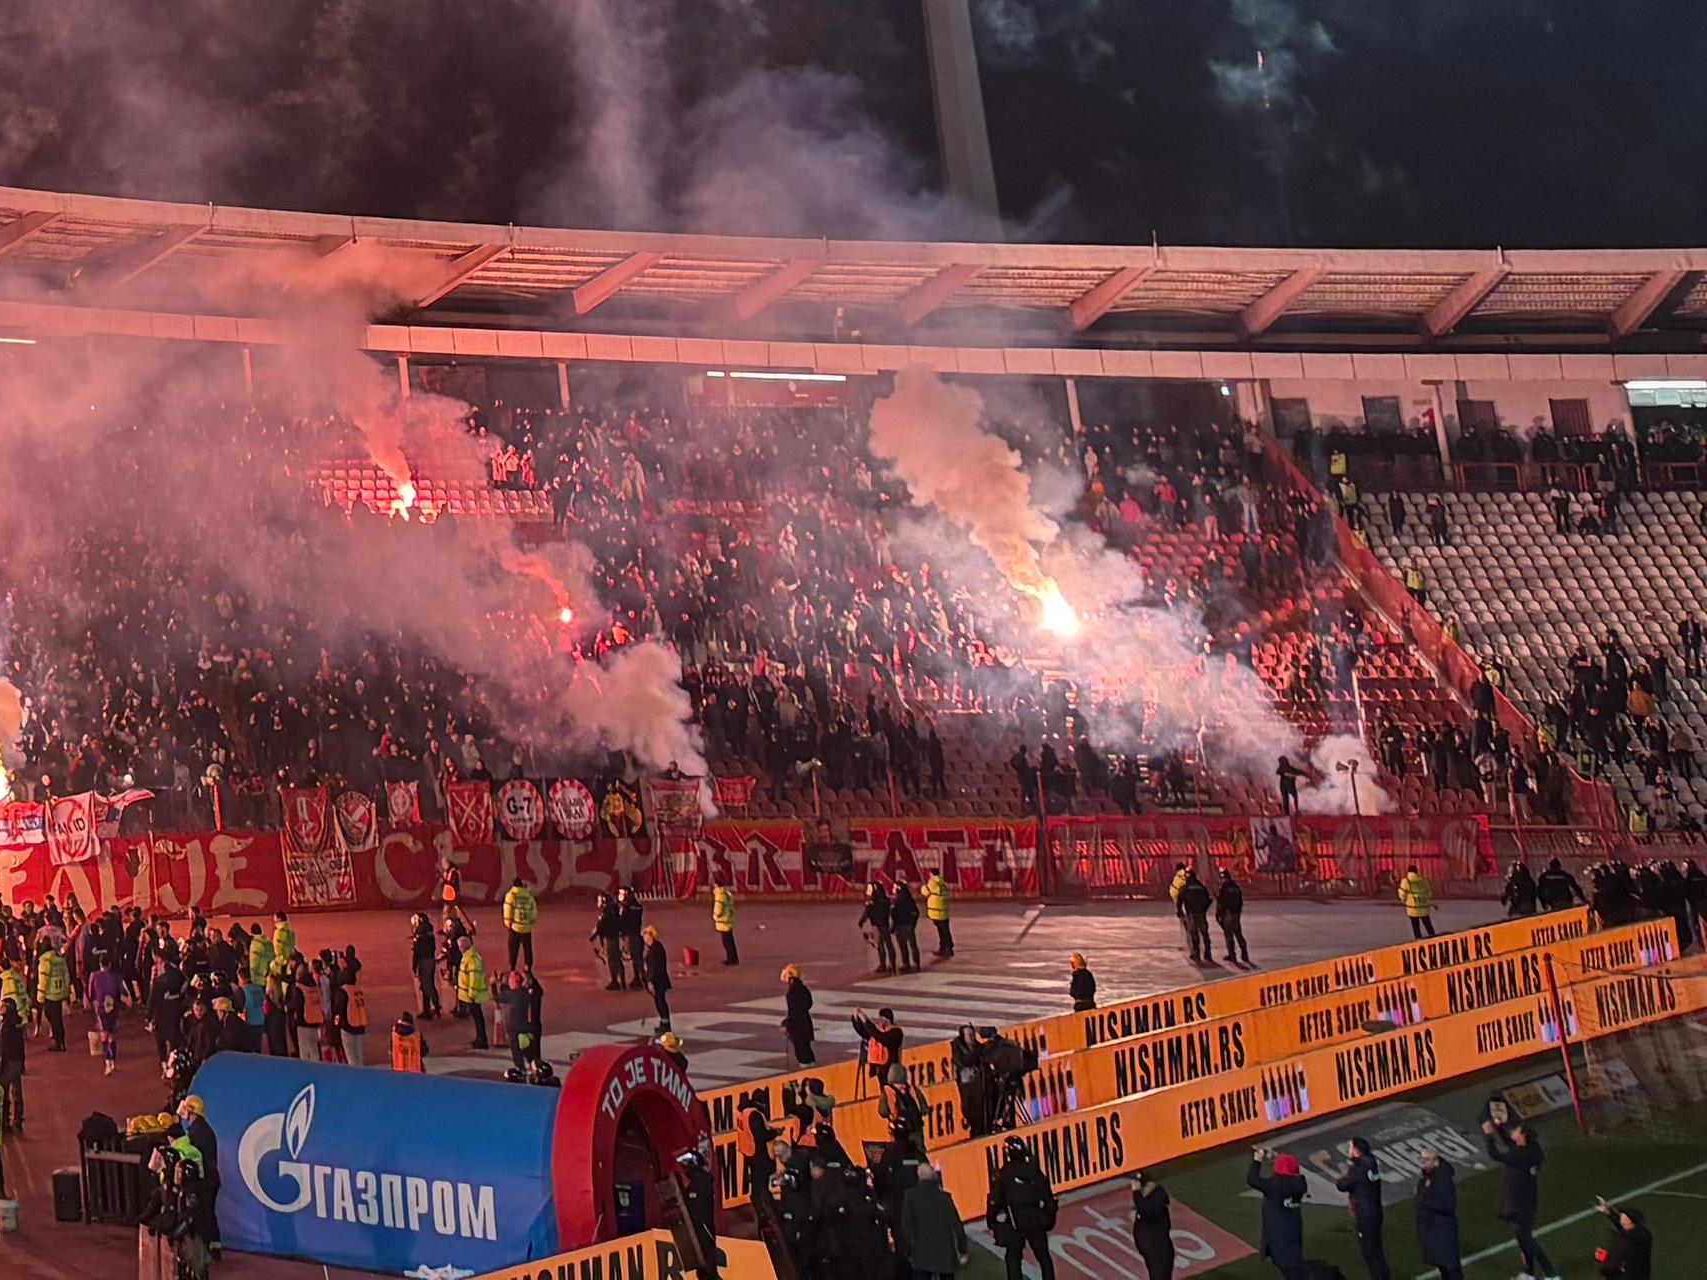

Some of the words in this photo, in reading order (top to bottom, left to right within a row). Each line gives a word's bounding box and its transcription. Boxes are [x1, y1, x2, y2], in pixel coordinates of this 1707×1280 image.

[506, 796, 533, 816] G-7
[1446, 952, 1543, 1014] NISHMAN.RS
[1299, 1008, 1334, 1044] AFTER
[1336, 999, 1372, 1034] SHAVE
[1476, 1020, 1506, 1054] AFTER
[1505, 1010, 1537, 1046] SHAVE
[1114, 1021, 1246, 1100] NISHMAN.RS
[1335, 1027, 1437, 1101] NISHMAN.RS
[1180, 1096, 1218, 1138] AFTER
[1220, 1084, 1259, 1128] SHAVE
[313, 1164, 498, 1241] ГАЗПРОМ
